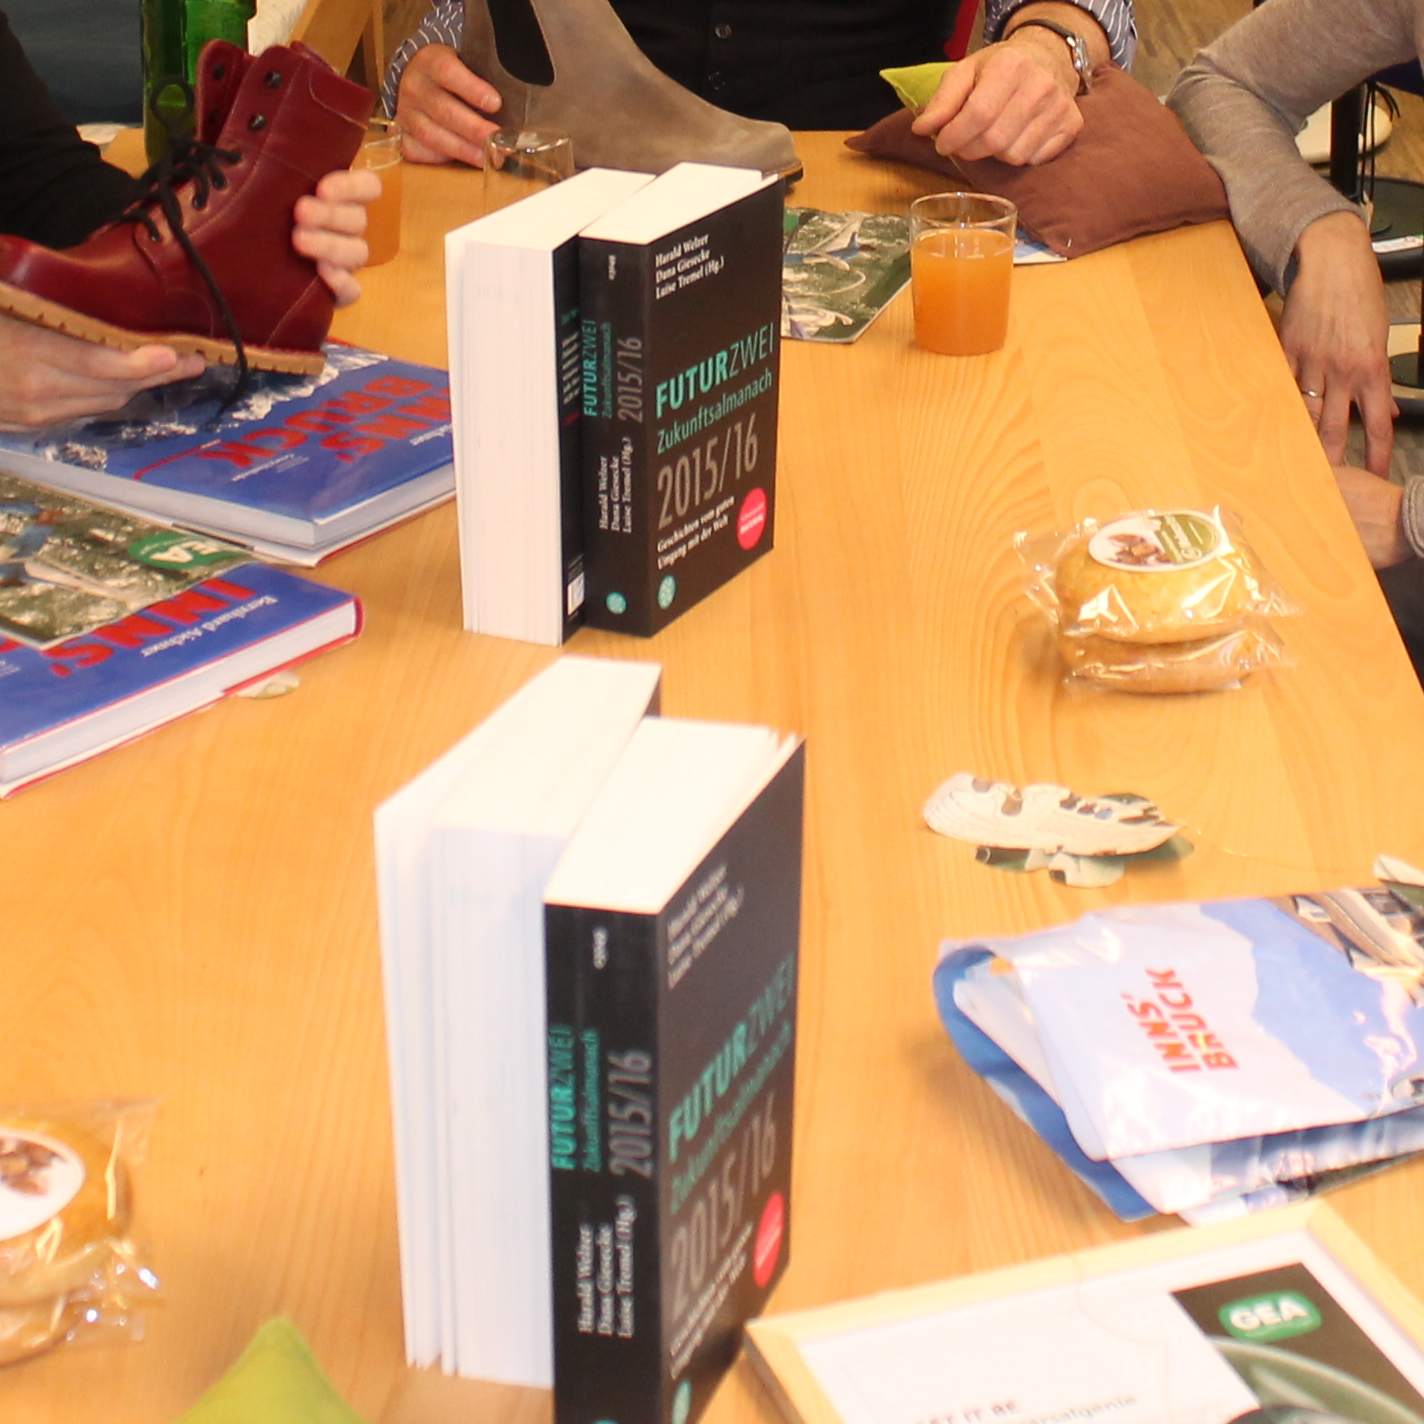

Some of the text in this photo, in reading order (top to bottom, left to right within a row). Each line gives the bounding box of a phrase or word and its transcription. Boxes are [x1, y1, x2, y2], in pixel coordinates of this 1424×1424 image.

[655, 234, 709, 268] Harald Welzer
[656, 249, 710, 283] Dana Giesecke
[656, 255, 724, 300] Luise Tremel (Hg.)
[582, 319, 597, 417] FUTURZWEI
[616, 336, 644, 423] 2015/16
[656, 321, 775, 419] FUTURZWEI
[657, 367, 773, 456] Zukunftsalmanach
[195, 374, 435, 469] BRUCK
[321, 386, 450, 463] NNS'
[598, 493, 609, 530] Harald
[657, 412, 758, 531] 2015/16
[149, 538, 221, 565] EA
[611, 504, 620, 532] Dana
[657, 517, 699, 553] Geschichten
[657, 543, 687, 570] Umgang
[688, 533, 699, 550] mit
[700, 523, 712, 542] der
[42, 577, 256, 678] INNS'
[669, 949, 795, 1163] FUTURZWEI
[1120, 992, 1202, 1073] INNS'
[1144, 967, 1239, 1070] BRUCK
[550, 1025, 576, 1170] FUTURZWEI
[608, 1049, 653, 1177] 2015/16
[670, 1089, 776, 1324] 2015/16
[1229, 1295, 1308, 1332] GEA
